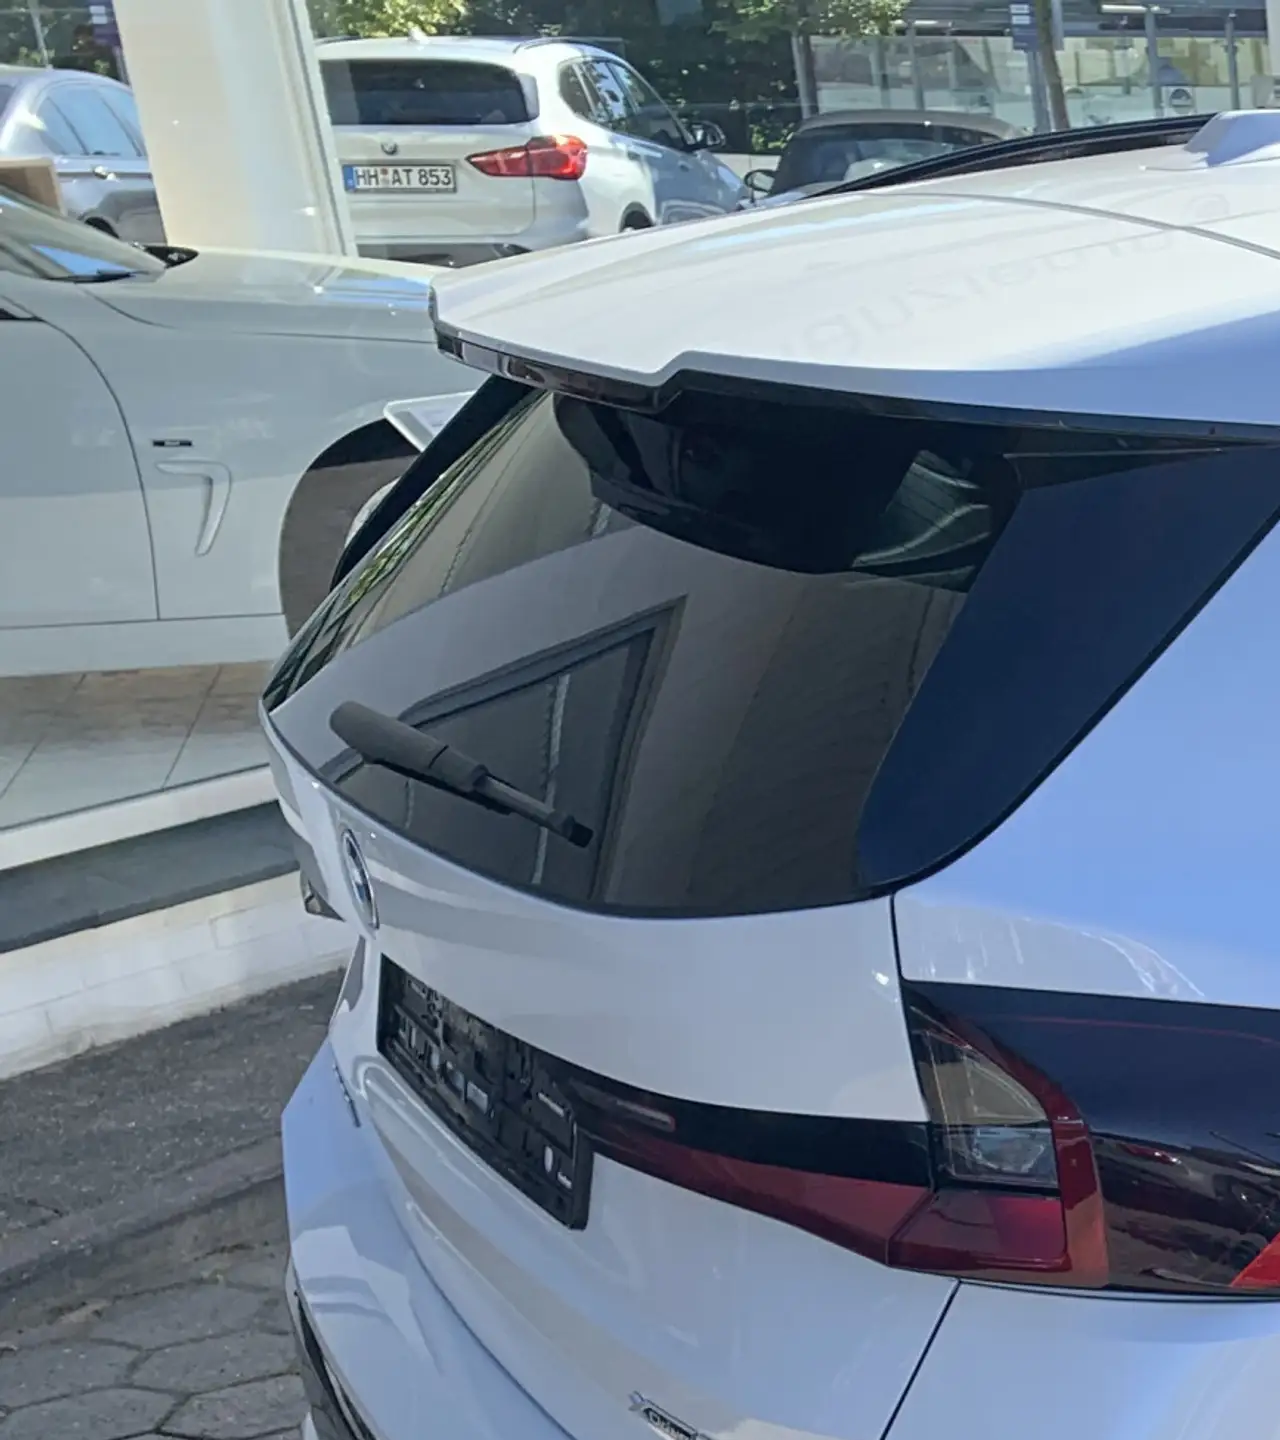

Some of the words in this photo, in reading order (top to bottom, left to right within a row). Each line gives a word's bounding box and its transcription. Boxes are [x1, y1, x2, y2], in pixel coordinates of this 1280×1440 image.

[355, 167, 379, 186] HH
[391, 168, 413, 186] AT
[417, 168, 452, 187] 853
